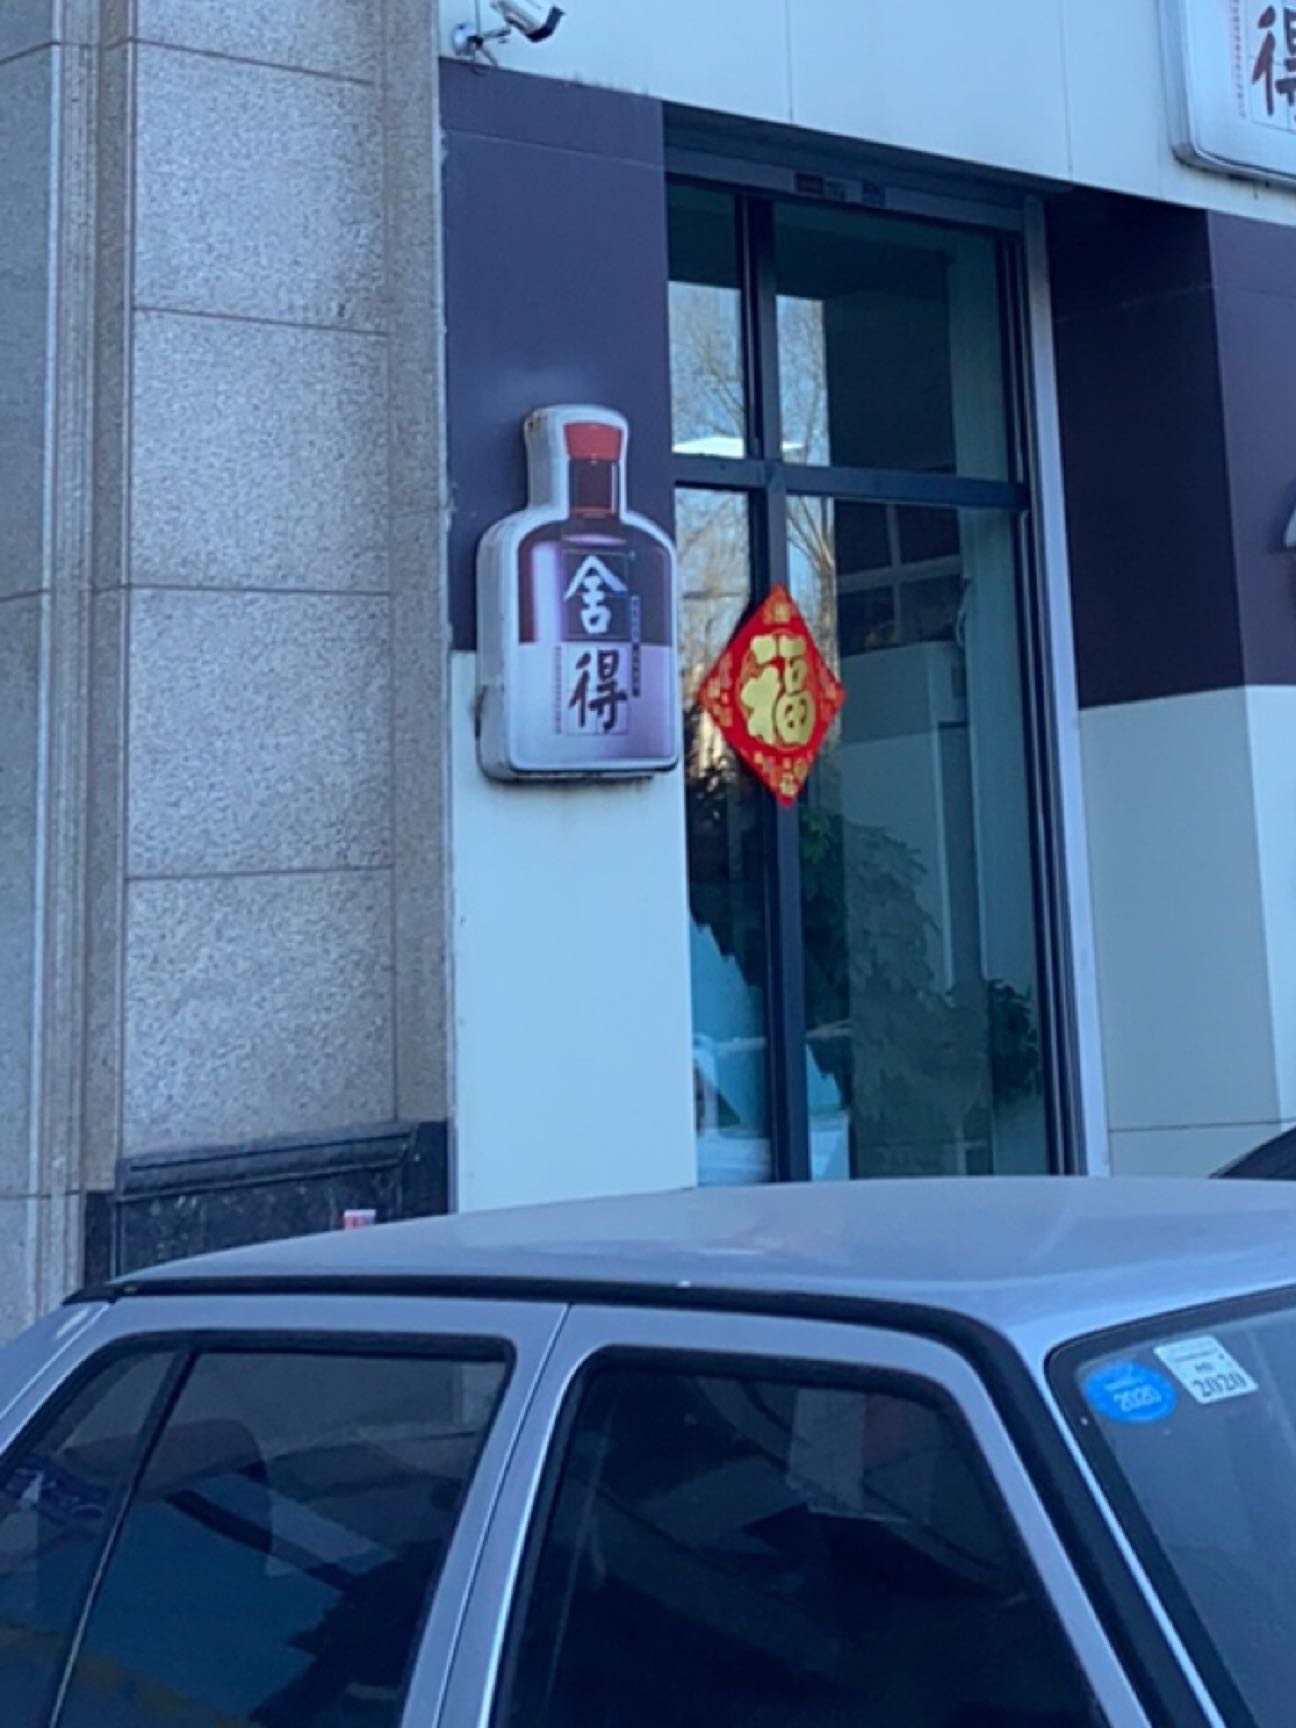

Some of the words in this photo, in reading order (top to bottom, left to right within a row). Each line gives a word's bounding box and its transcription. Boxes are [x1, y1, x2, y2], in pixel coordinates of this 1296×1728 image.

[564, 555, 628, 735] 舍得
[740, 633, 816, 747] 福
[1193, 1372, 1247, 1398] 2020
